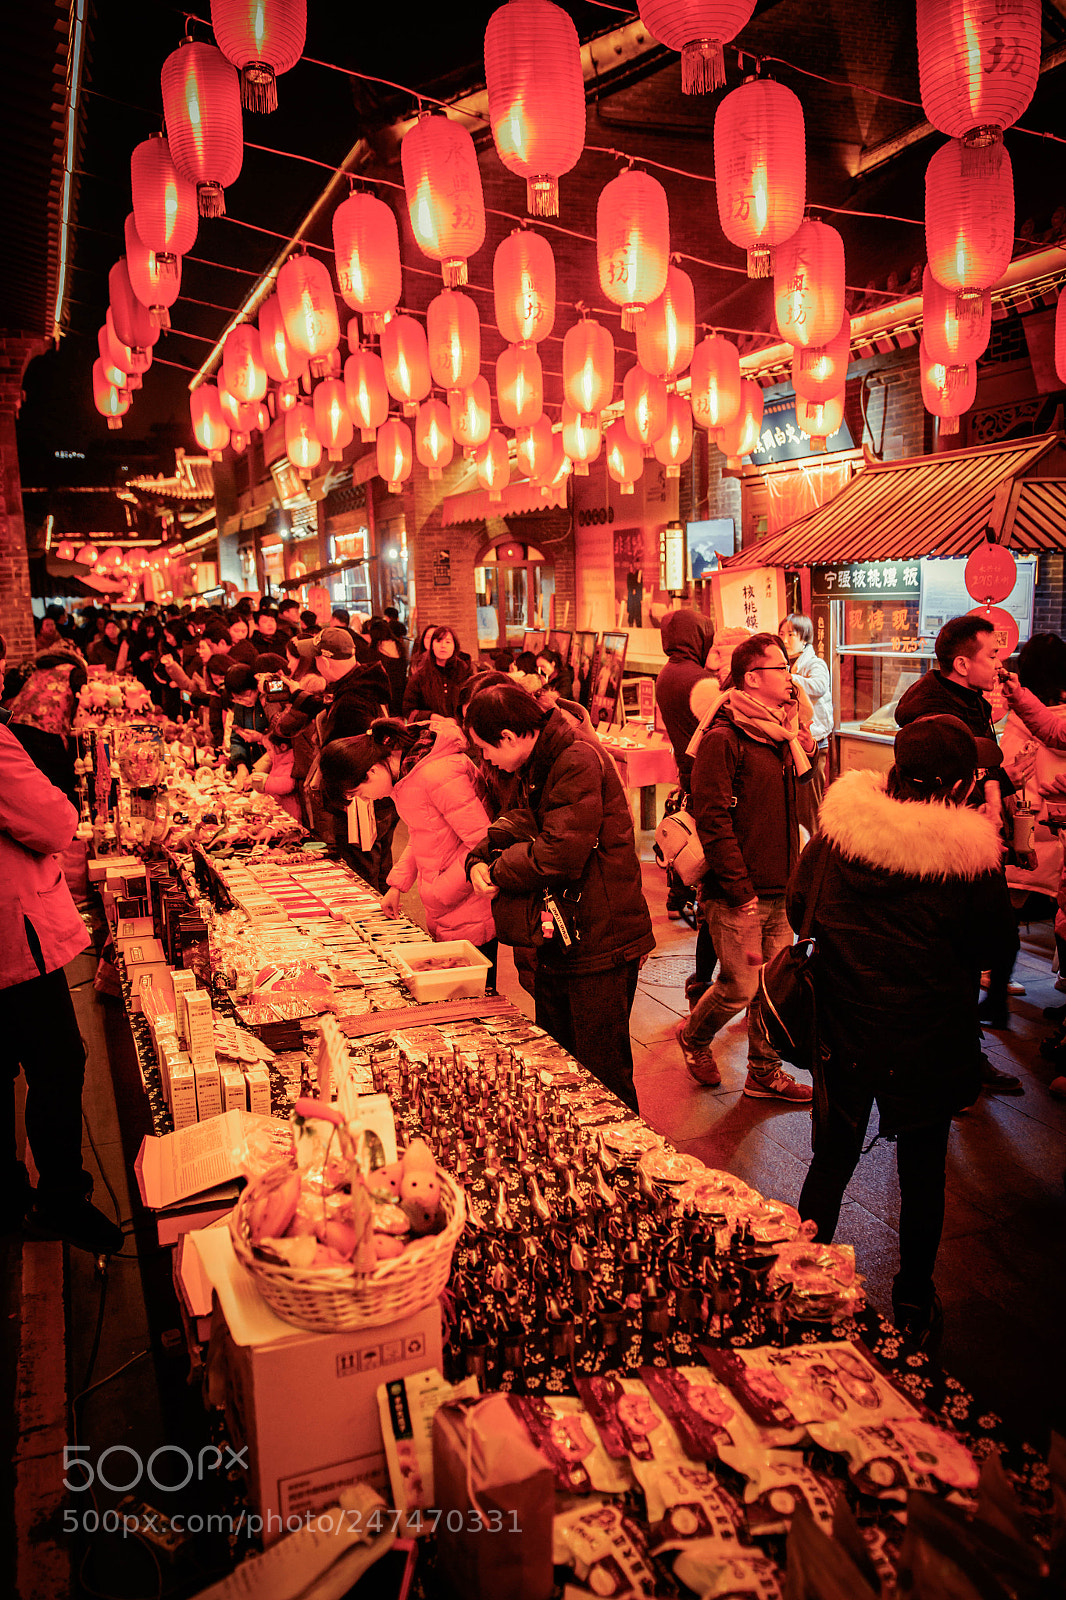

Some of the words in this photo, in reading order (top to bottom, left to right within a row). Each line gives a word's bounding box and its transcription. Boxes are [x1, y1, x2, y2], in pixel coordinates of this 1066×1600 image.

[848, 609, 920, 632] 现烤现
[891, 637, 928, 653] 10元5个
